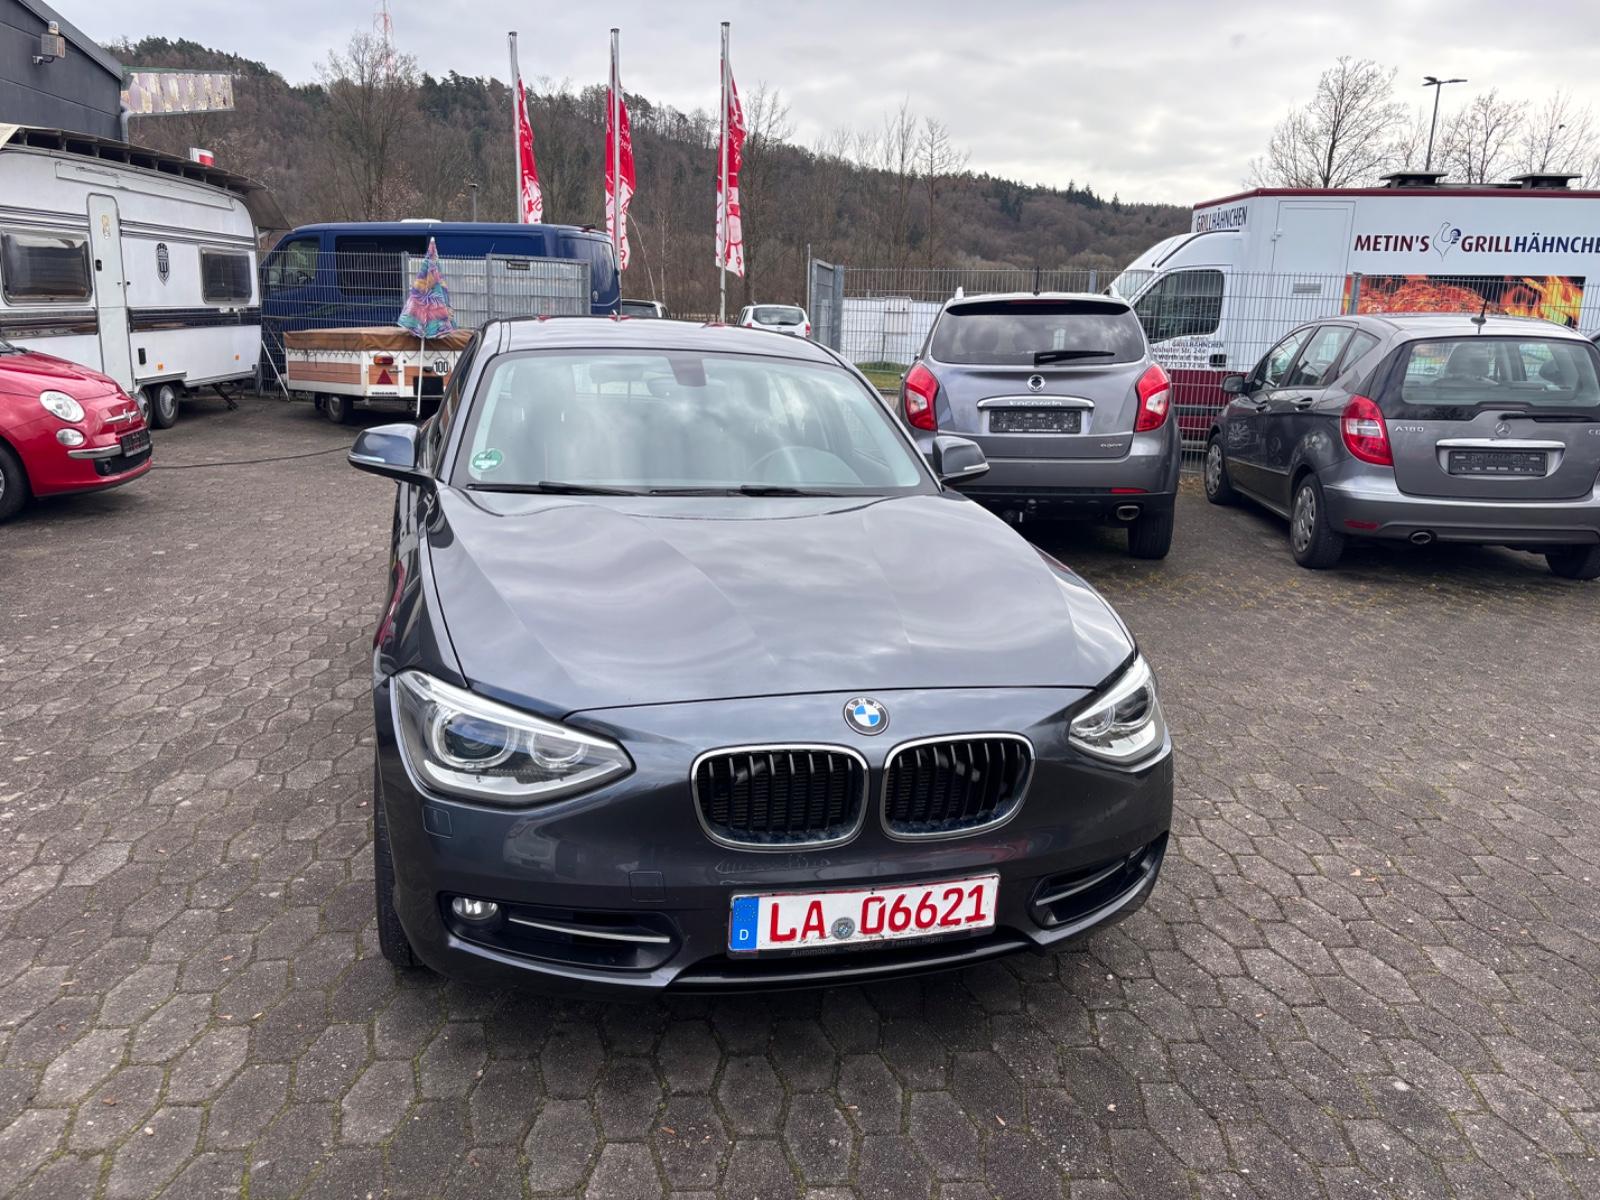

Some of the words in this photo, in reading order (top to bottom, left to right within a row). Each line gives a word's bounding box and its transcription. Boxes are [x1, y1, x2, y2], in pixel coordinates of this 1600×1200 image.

[1354, 234, 1430, 252] METIN'S
[434, 361, 449, 373] 100
[770, 899, 827, 942] LA
[861, 885, 986, 934] 06621
[738, 928, 750, 942] D
